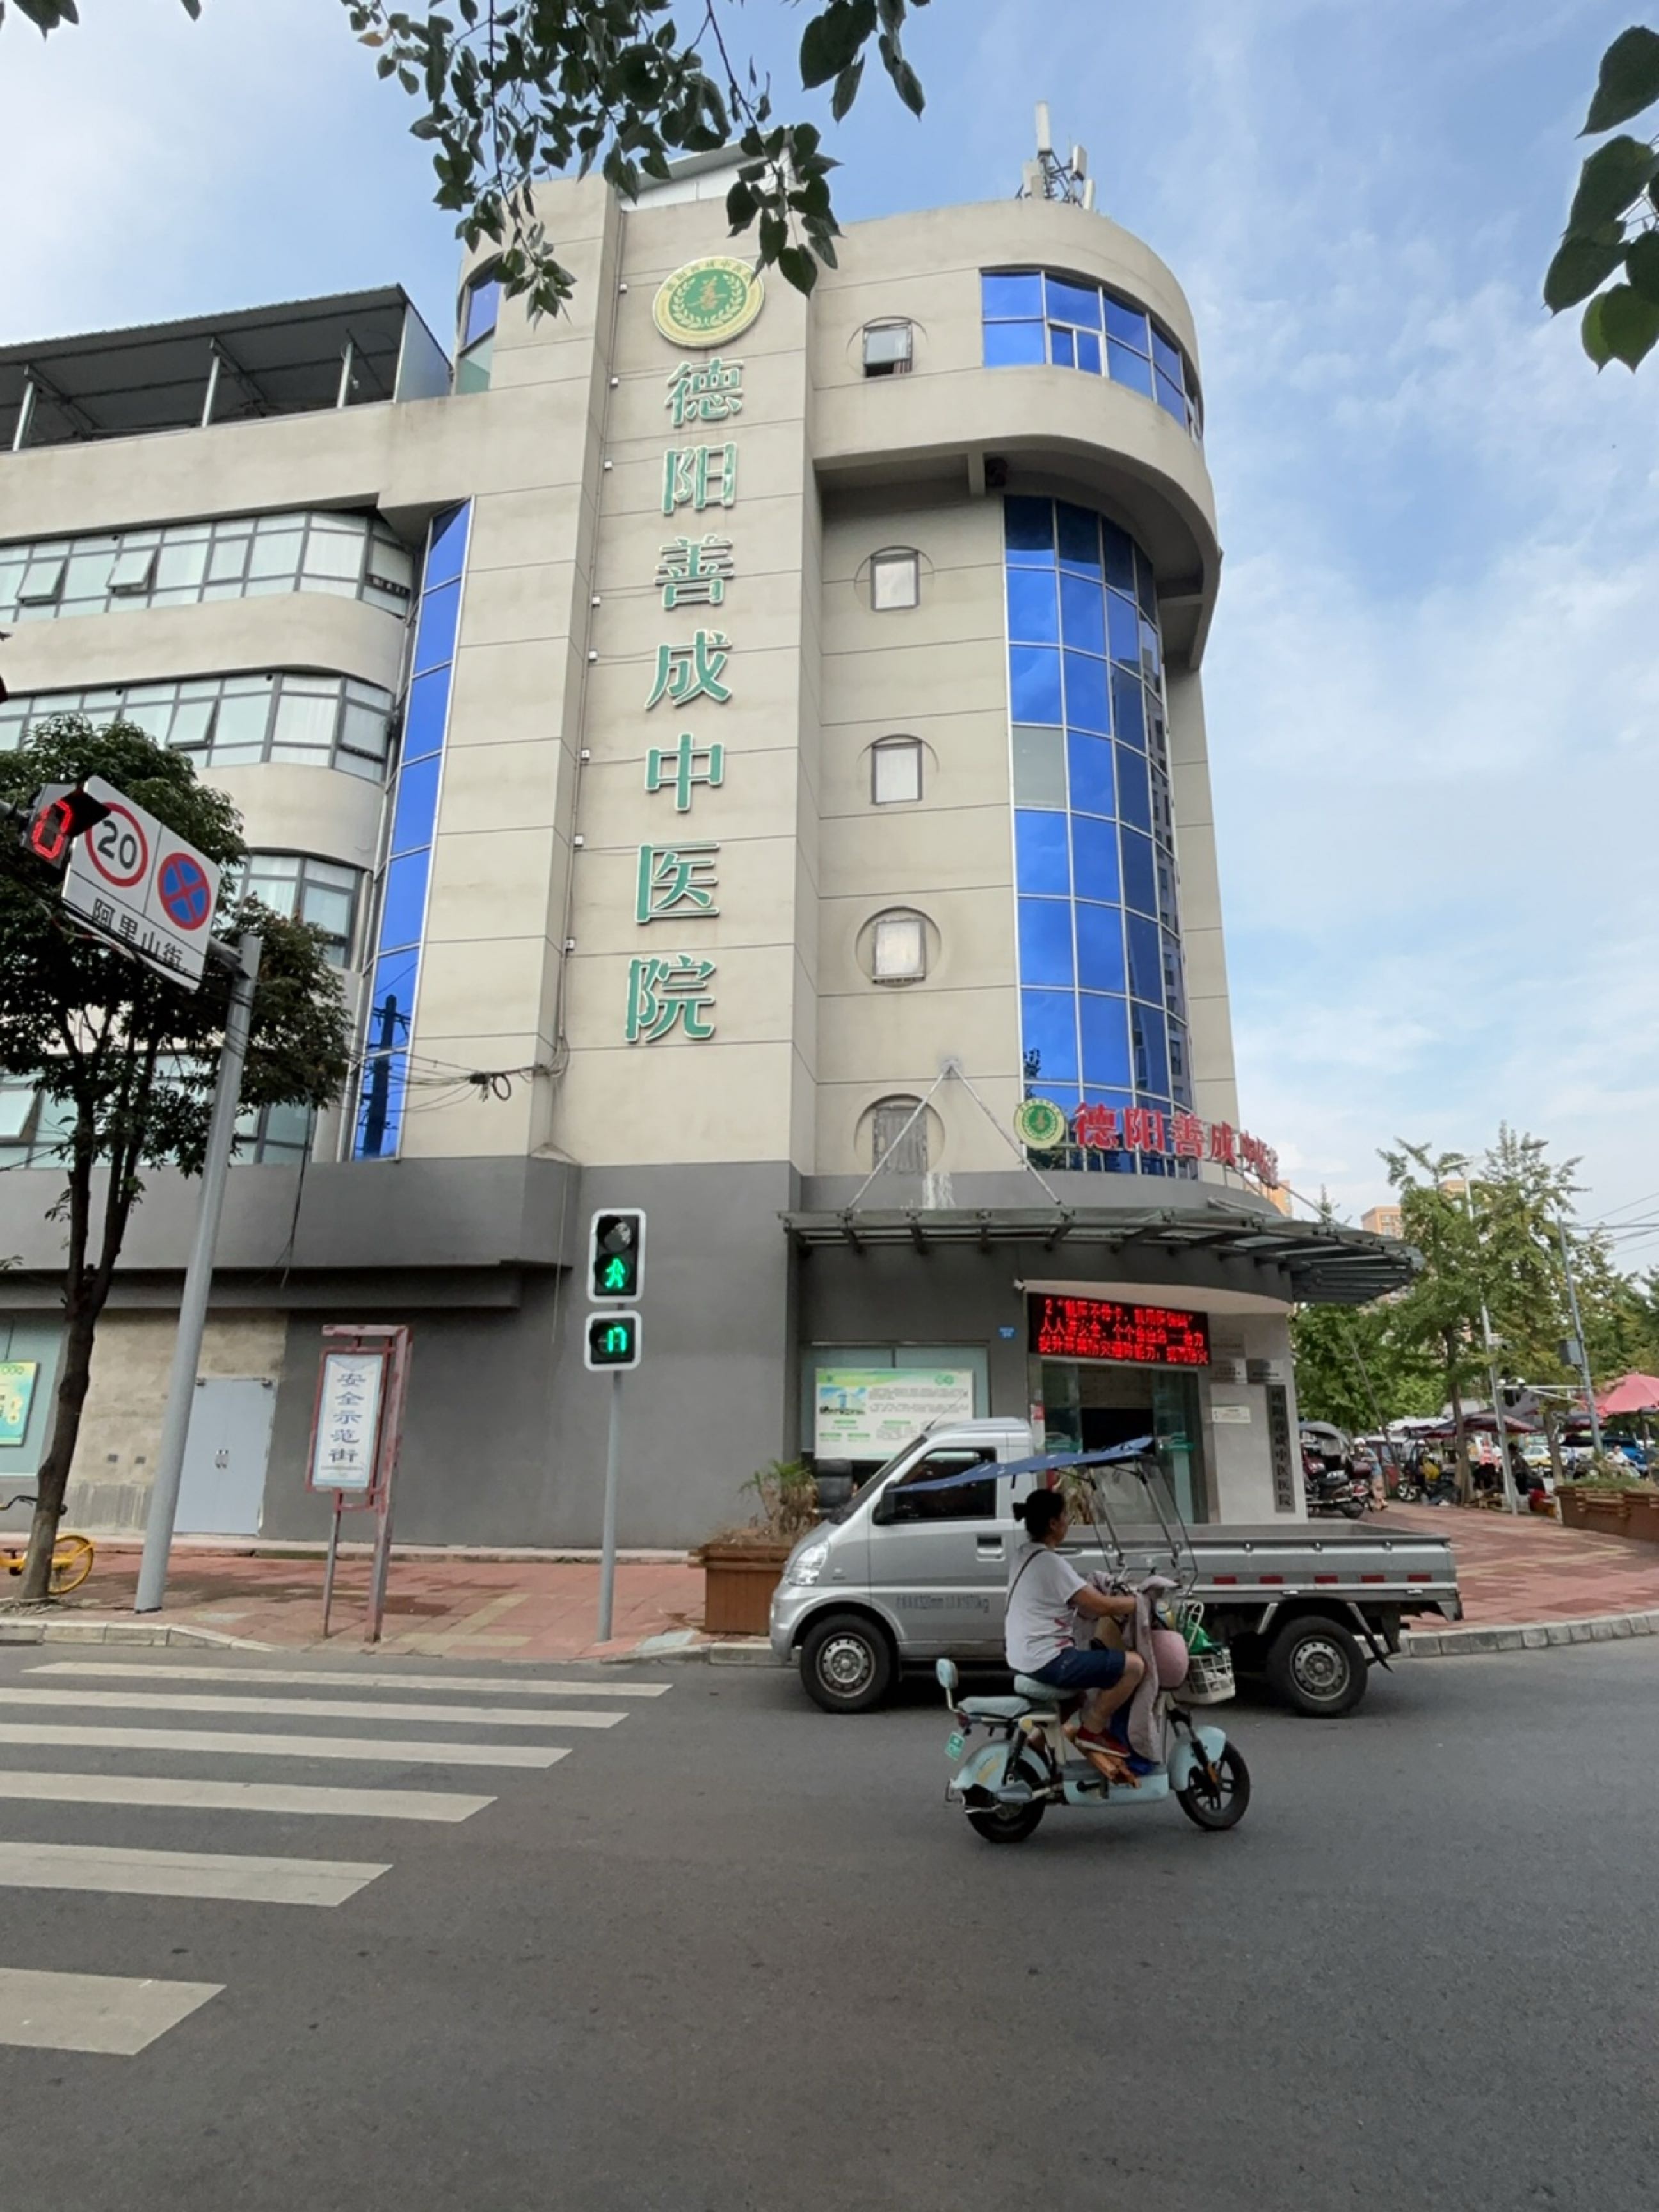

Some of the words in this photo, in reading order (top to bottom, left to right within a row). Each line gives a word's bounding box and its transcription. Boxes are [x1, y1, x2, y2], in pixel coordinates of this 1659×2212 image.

[625, 356, 746, 1044] 德阳善成中医院
[97, 819, 138, 870] 20
[92, 897, 184, 968] 阿里山街
[328, 1372, 366, 1463] 安全示范街
